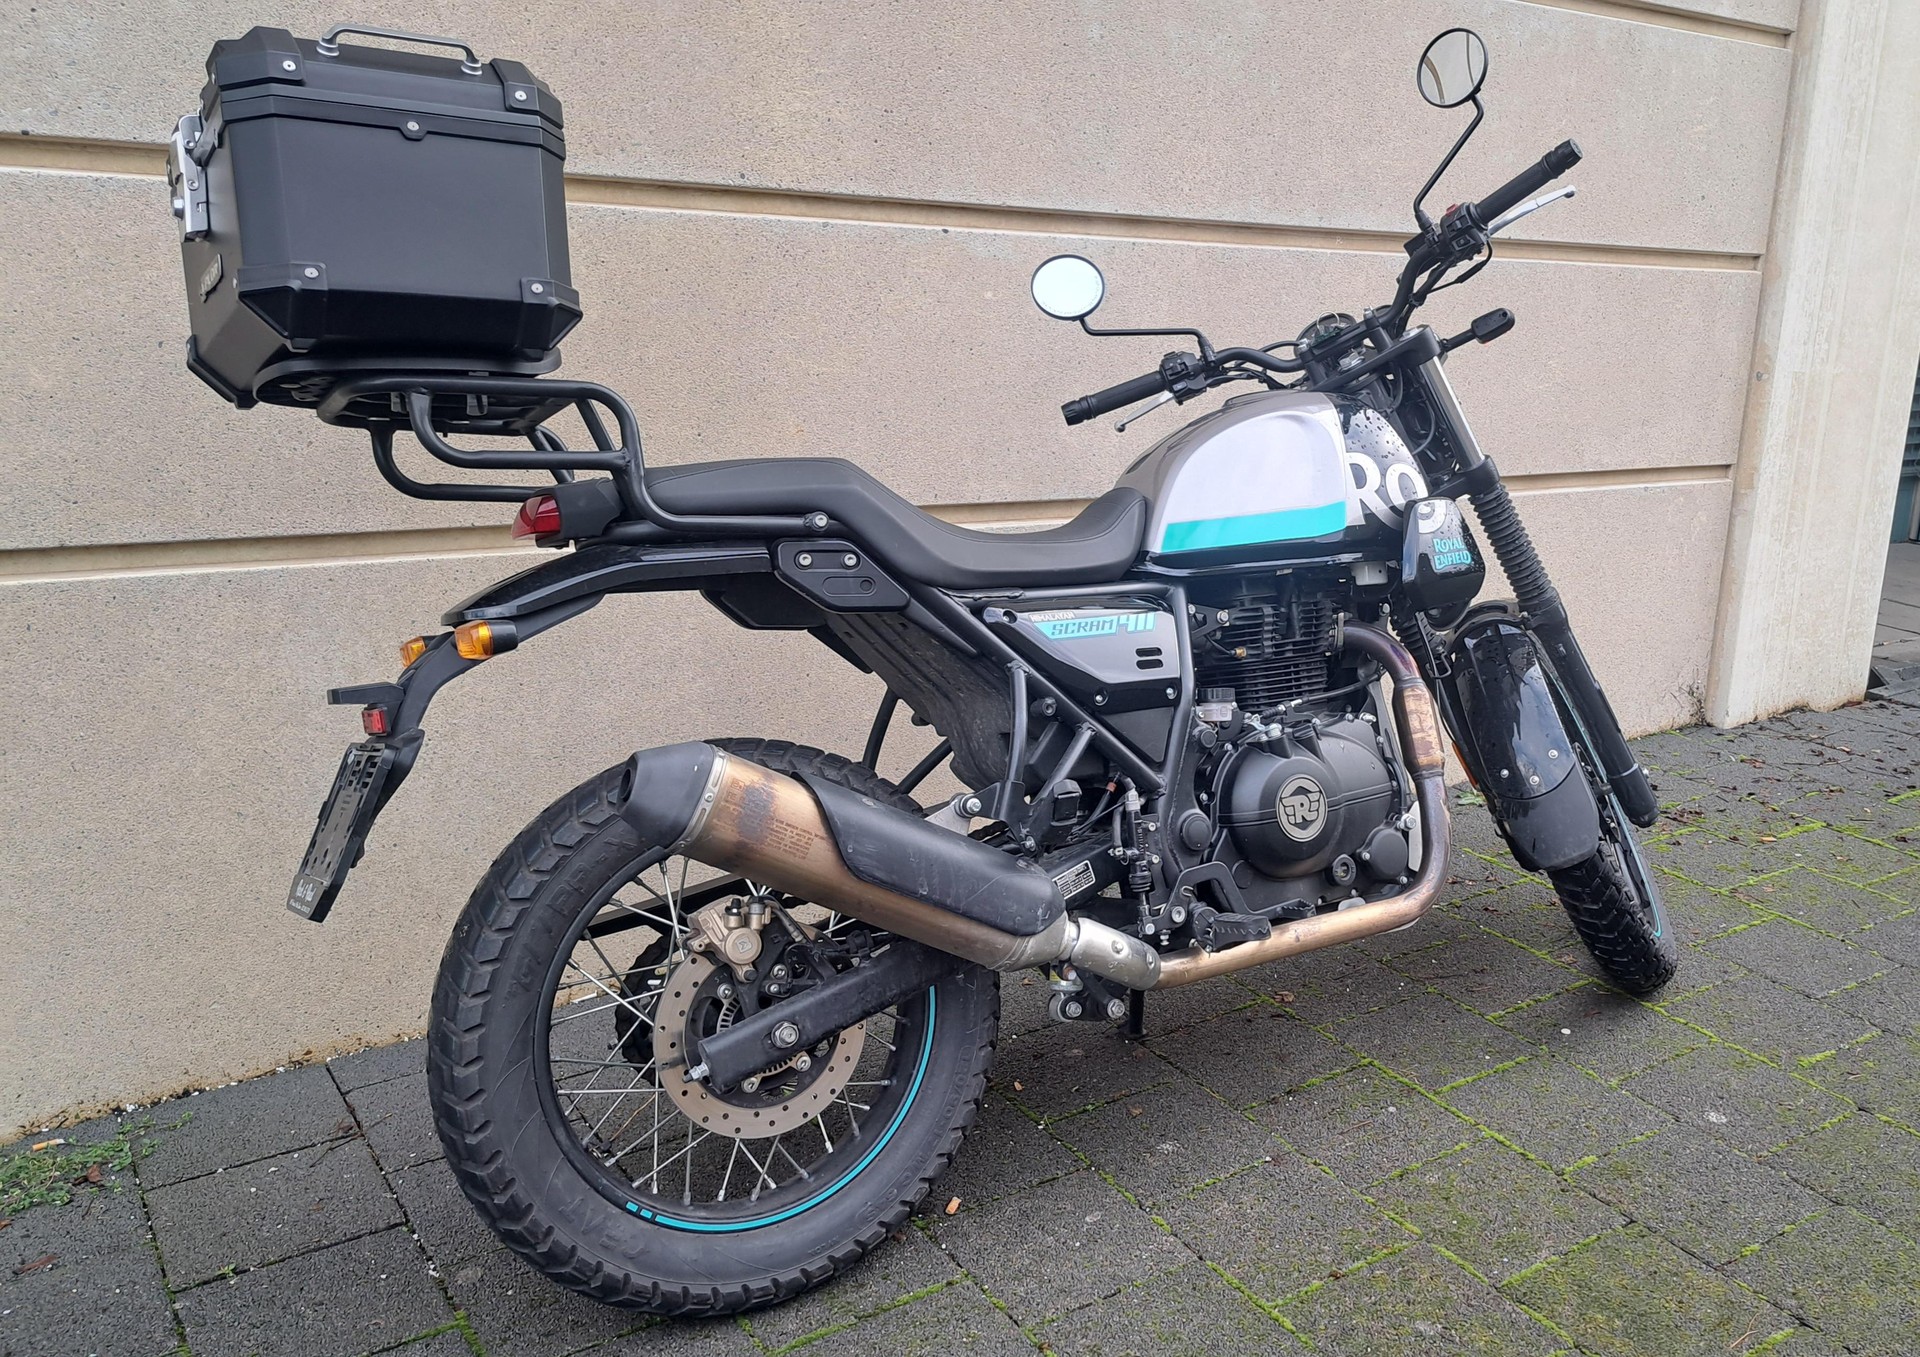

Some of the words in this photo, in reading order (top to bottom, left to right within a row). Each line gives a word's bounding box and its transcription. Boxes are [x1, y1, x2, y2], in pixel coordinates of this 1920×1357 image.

[1433, 537, 1465, 553] ROYAL
[1433, 550, 1472, 570] ENFIELD
[1051, 619, 1114, 636] SCRAM
